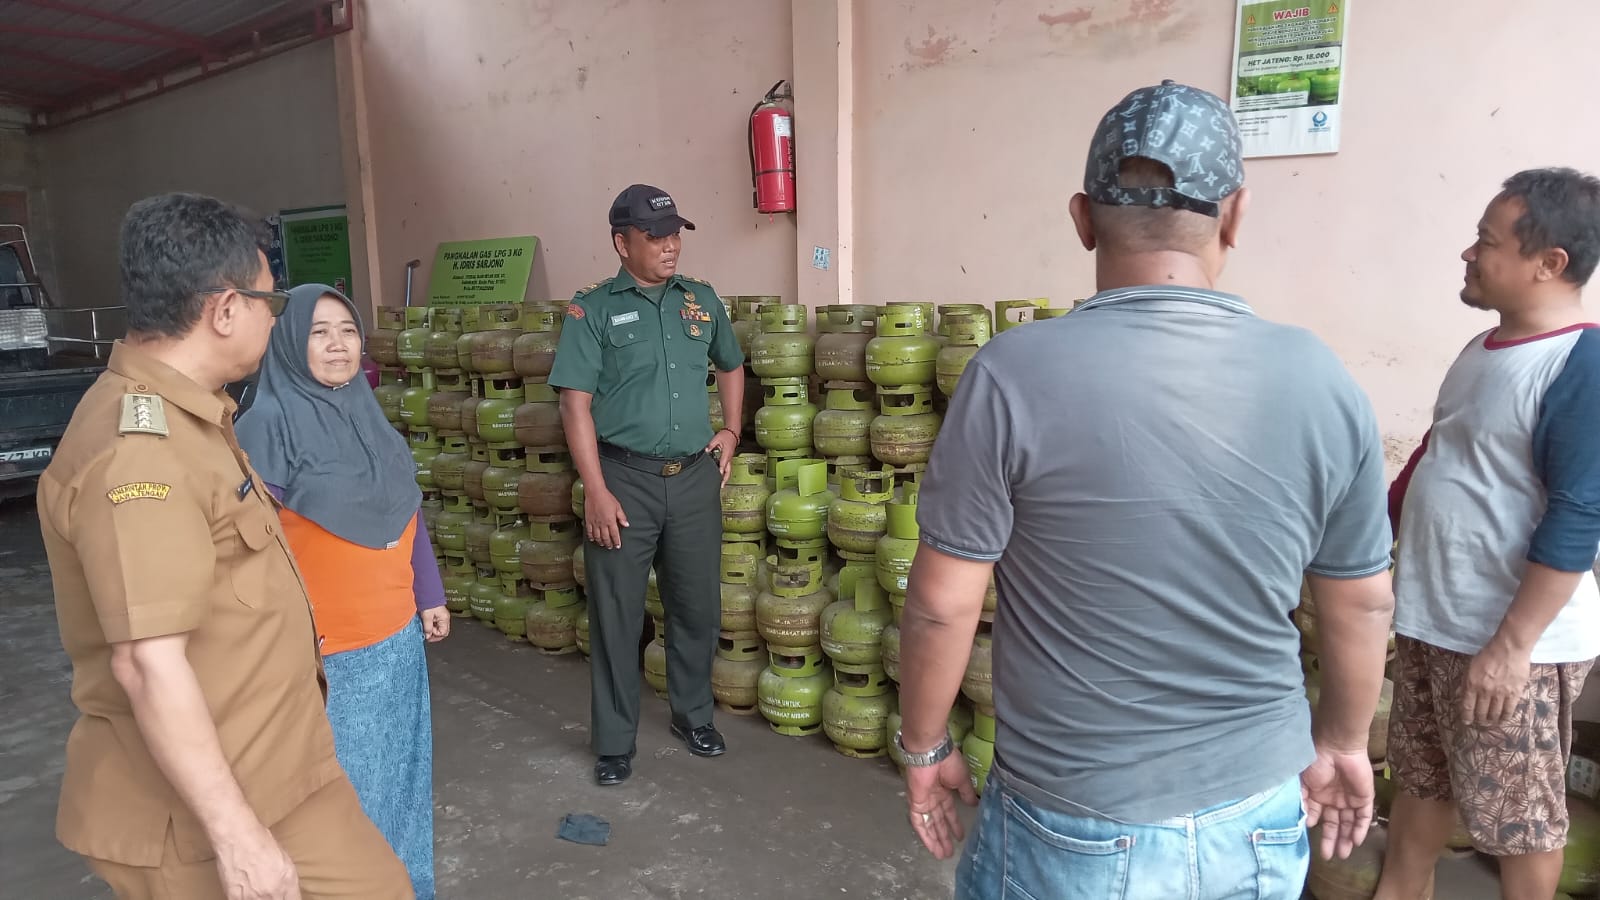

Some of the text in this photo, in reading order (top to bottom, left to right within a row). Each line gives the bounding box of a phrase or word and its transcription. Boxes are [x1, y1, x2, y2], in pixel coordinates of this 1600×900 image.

[1273, 7, 1310, 20] WAJIB
[1293, 55, 1305, 63] Rp.
[444, 248, 523, 260] PANGKALAN GAS LPG 3 KG
[460, 260, 475, 270] IDRIS
[476, 259, 505, 269] SARJONO
[116, 492, 138, 501] JAWA
[782, 699, 801, 708] UNTUK
